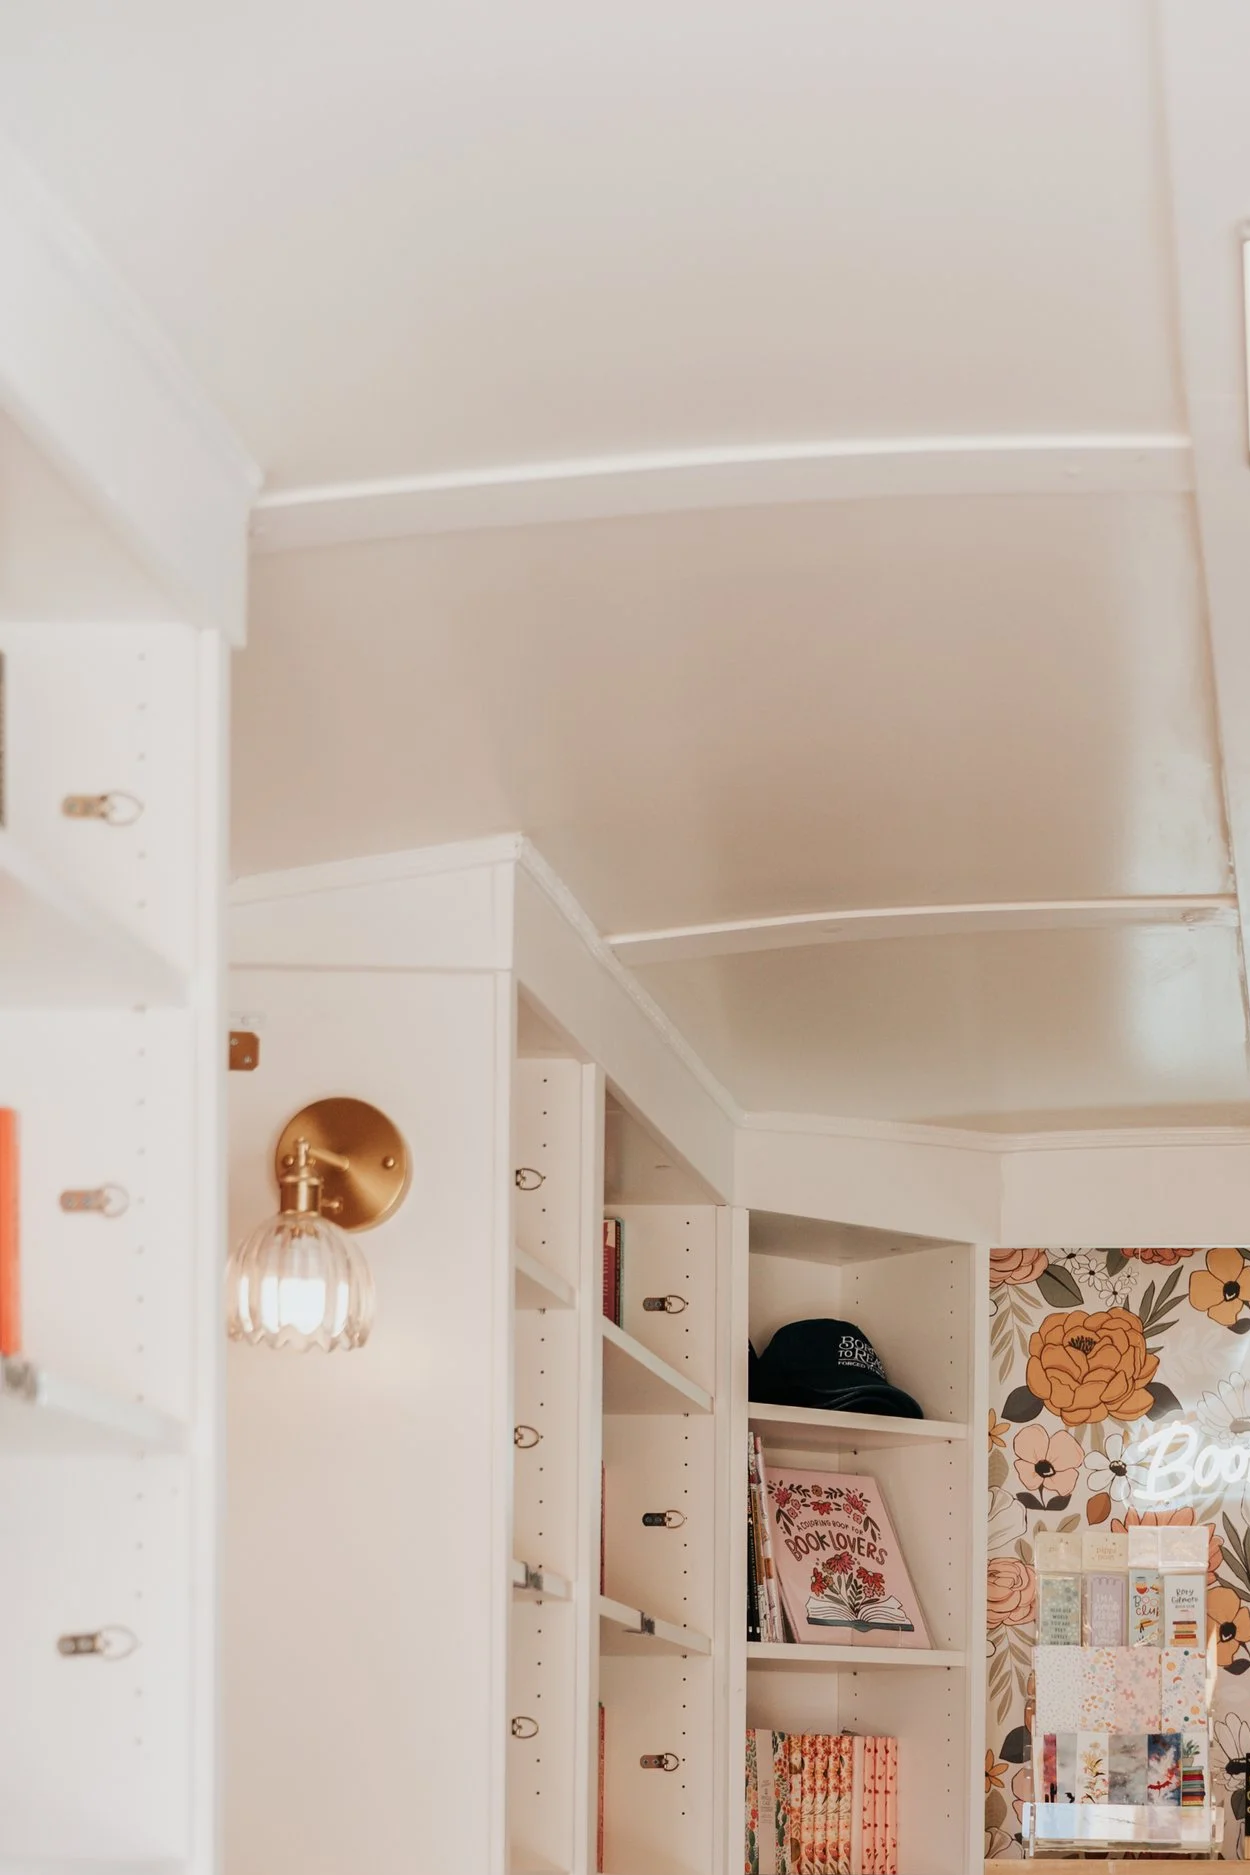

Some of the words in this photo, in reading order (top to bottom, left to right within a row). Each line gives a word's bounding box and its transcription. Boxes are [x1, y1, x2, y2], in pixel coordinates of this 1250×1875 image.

[838, 1361, 866, 1369] FORCED
[800, 1520, 831, 1530] COLORING
[832, 1521, 849, 1529] BOOK
[852, 1526, 864, 1535] FOR
[785, 1530, 830, 1562] BOOK
[829, 1530, 888, 1565] LOVERS
